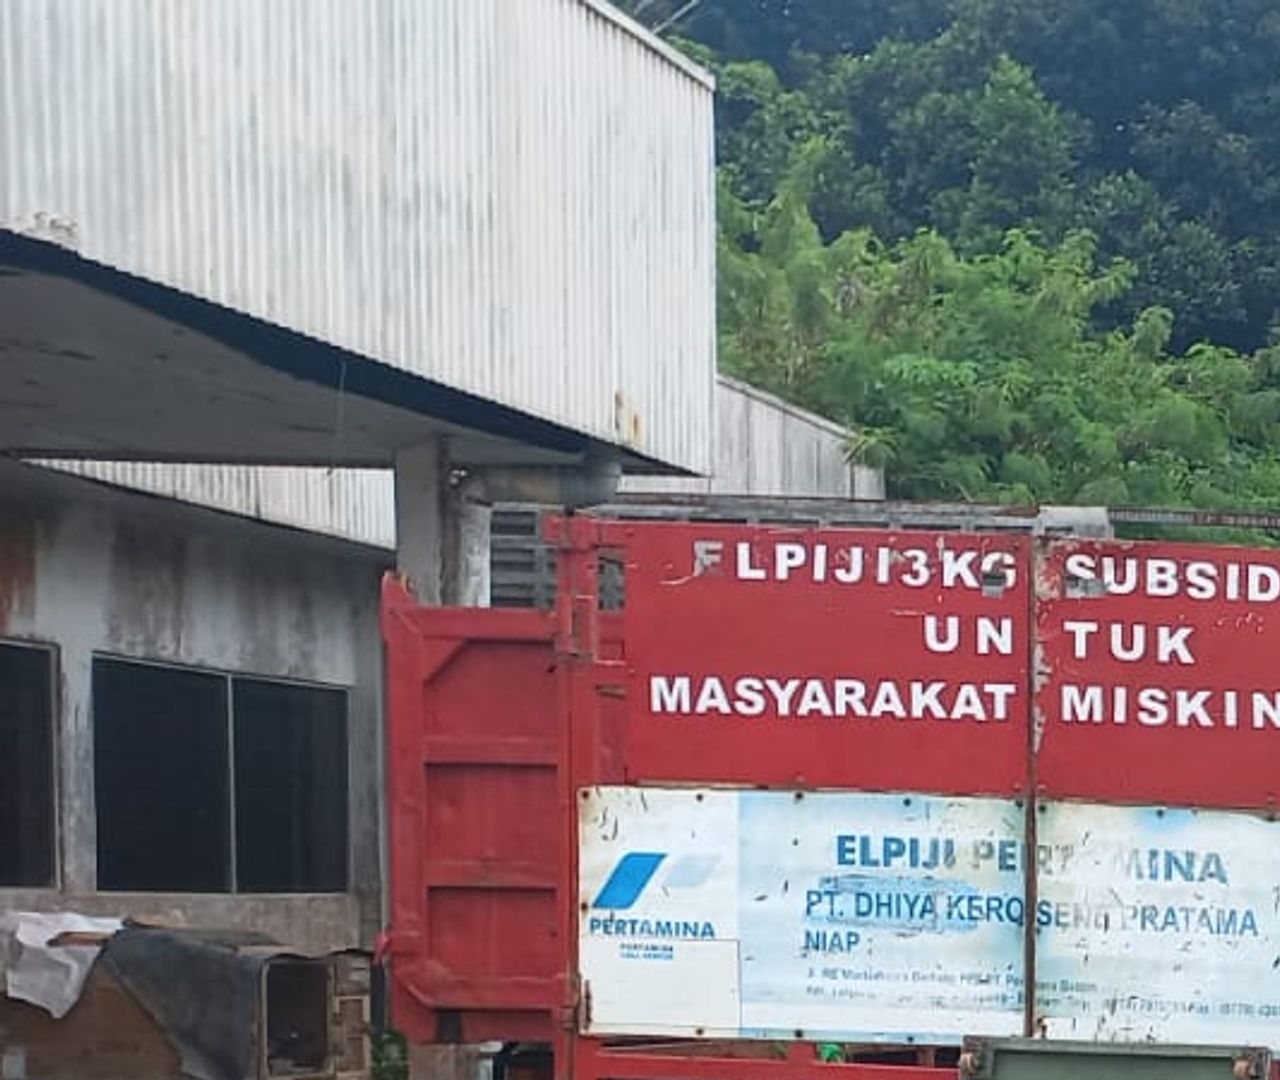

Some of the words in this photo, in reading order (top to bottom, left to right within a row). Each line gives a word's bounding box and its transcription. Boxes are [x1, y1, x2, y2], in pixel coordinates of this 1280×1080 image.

[650, 676, 1016, 720] MASYARAKAT
[837, 835, 956, 869] ELPIJI
[806, 890, 843, 917] PT.
[855, 893, 936, 919] DHIYA
[590, 917, 716, 939] PERTAMINA
[804, 930, 860, 952] NIAP
